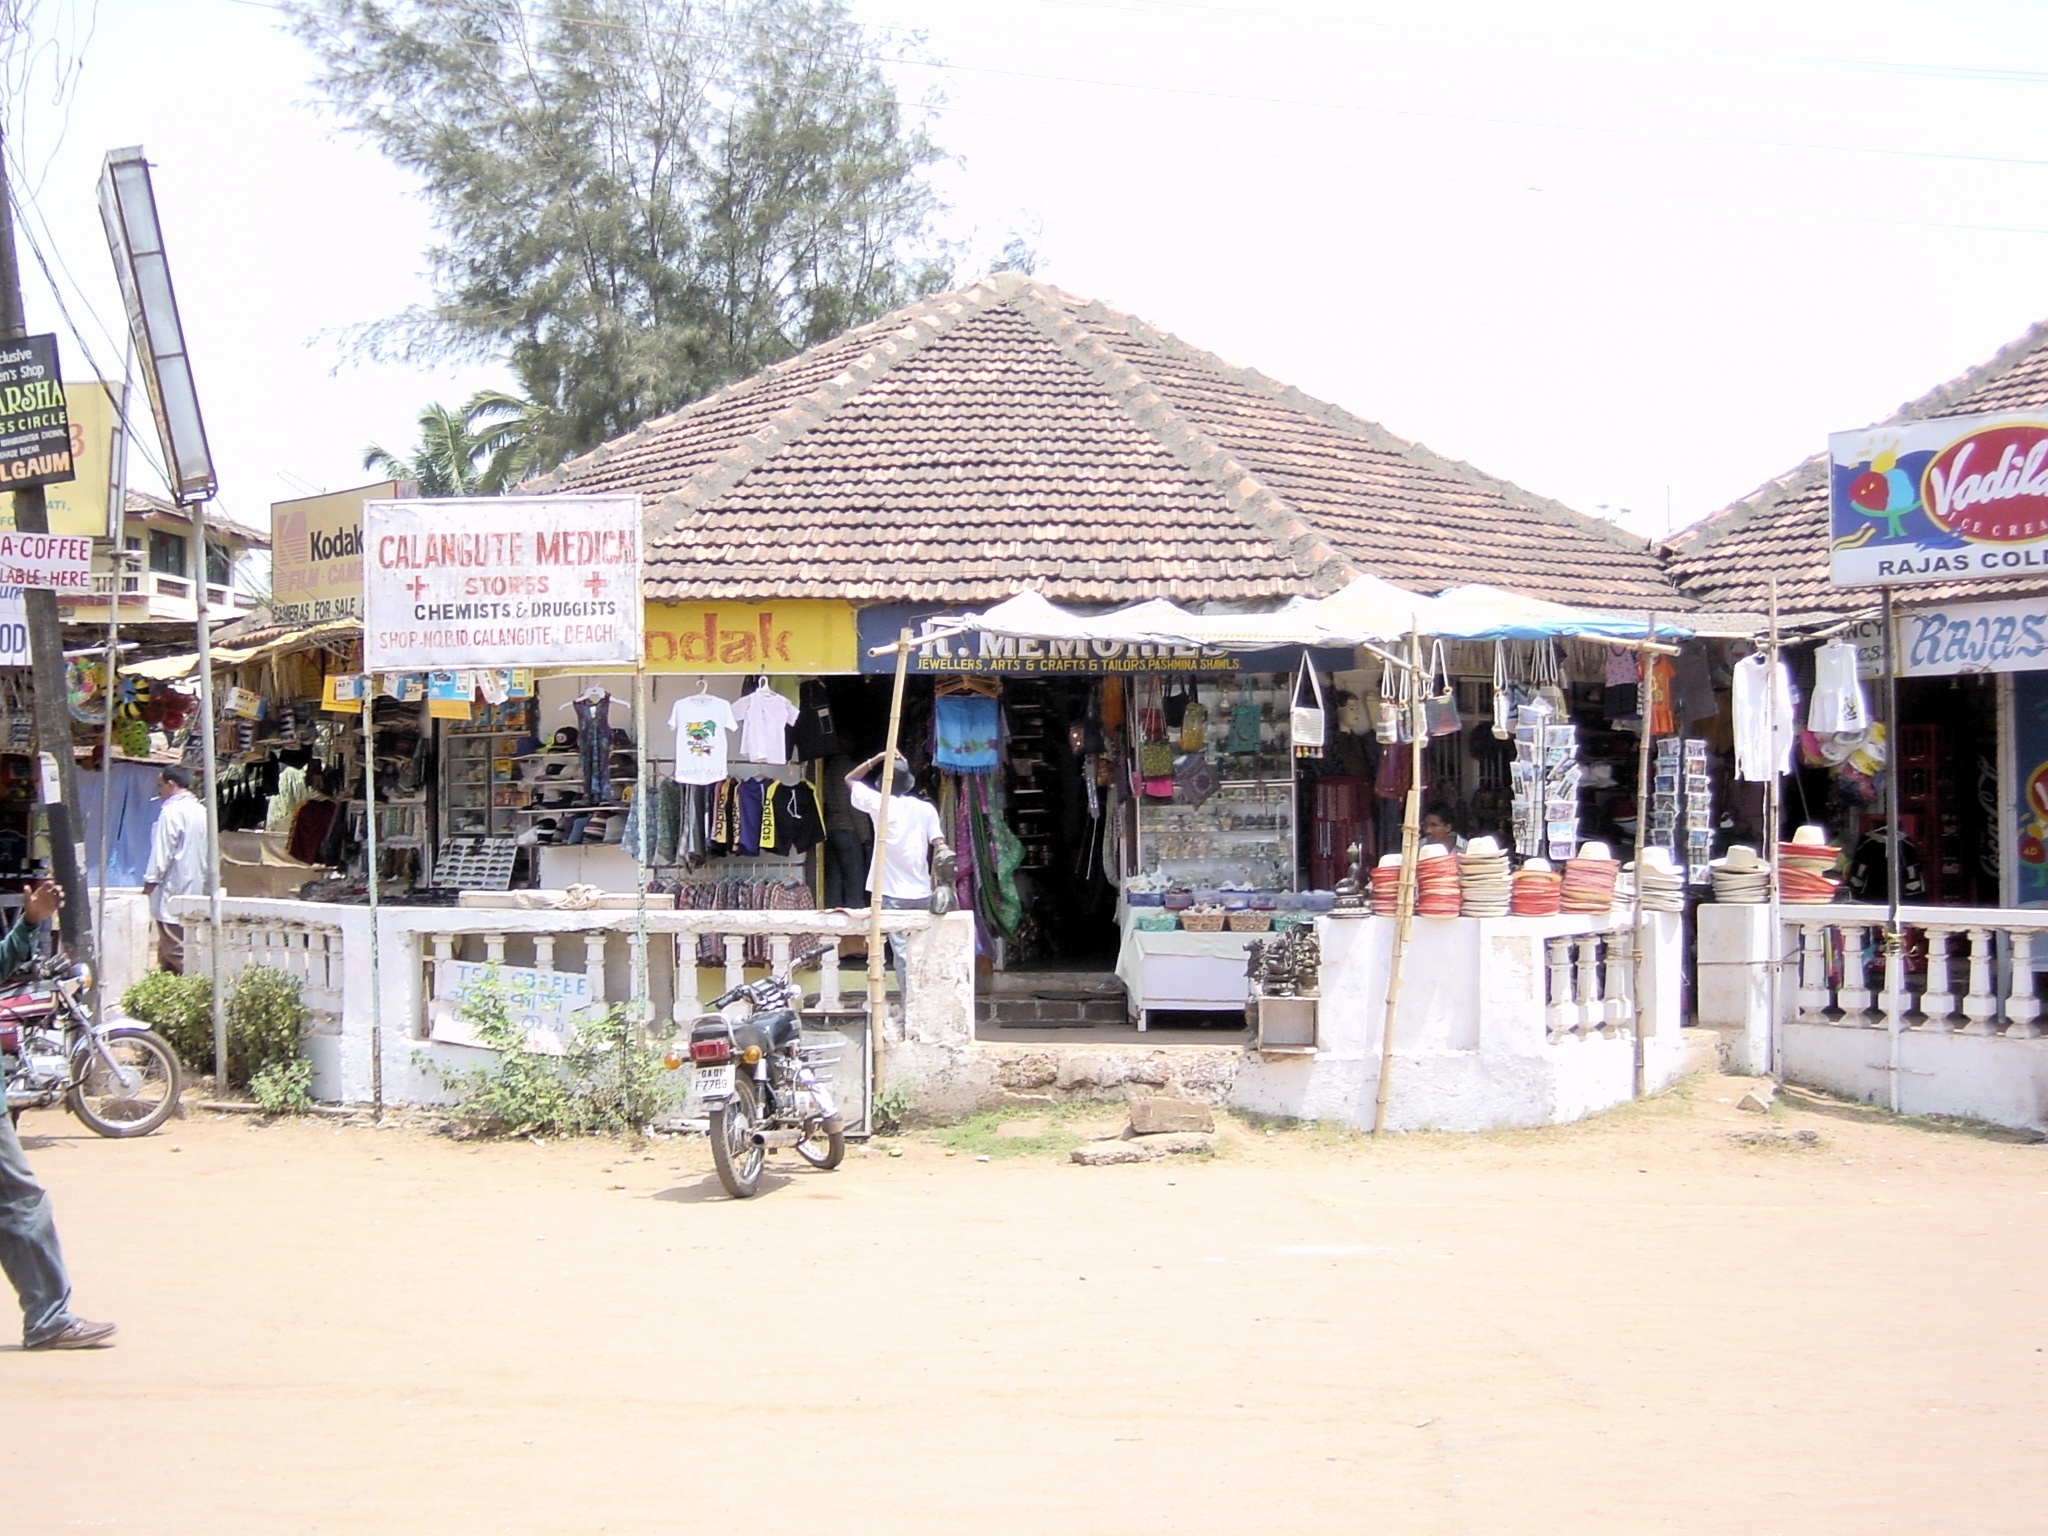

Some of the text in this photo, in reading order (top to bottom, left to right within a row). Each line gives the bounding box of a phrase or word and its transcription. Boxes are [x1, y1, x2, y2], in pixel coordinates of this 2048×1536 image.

[20, 364, 45, 379] Shop
[18, 411, 67, 431] CIRCLE
[310, 524, 364, 561] Kodak
[378, 532, 522, 569] CALANGUTE
[1877, 554, 1969, 576] RAJAS
[465, 575, 550, 596] STORES
[314, 600, 331, 620] FOR
[335, 597, 356, 617] SALE
[531, 601, 616, 618] DRUGGISTS
[978, 630, 1229, 660] MEMO
[1909, 609, 2047, 668] RAJAS
[990, 659, 1020, 671] ARTS
[1026, 659, 1035, 671] &
[1040, 659, 1085, 671] CRAFTS
[1088, 659, 1098, 671] &
[763, 797, 773, 841] adidas
